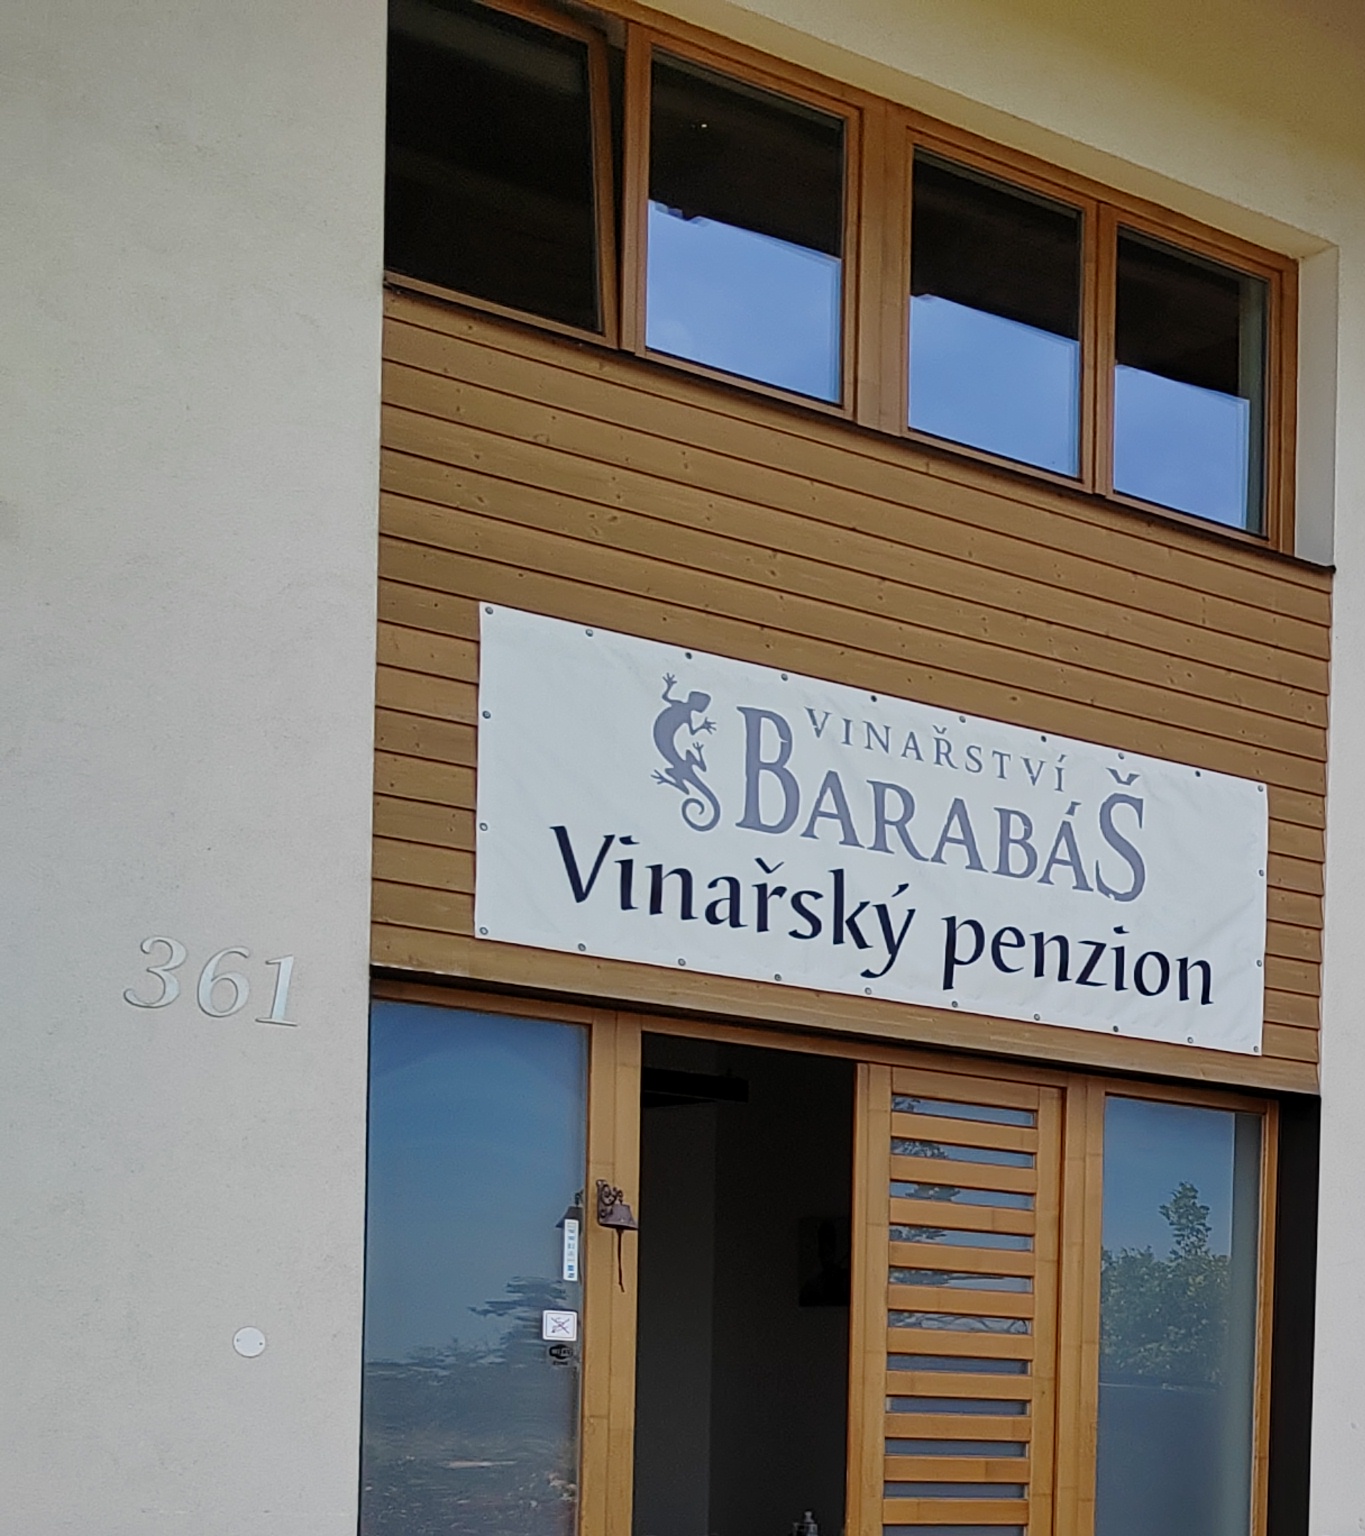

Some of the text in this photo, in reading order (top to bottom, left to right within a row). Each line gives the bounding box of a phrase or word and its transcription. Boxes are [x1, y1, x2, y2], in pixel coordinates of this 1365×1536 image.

[735, 705, 1147, 903] BARABÁŠ
[803, 705, 1068, 793] VINAŘSTVÍ
[122, 935, 299, 1028] 361
[549, 824, 1215, 1006] Vinařský penzion
